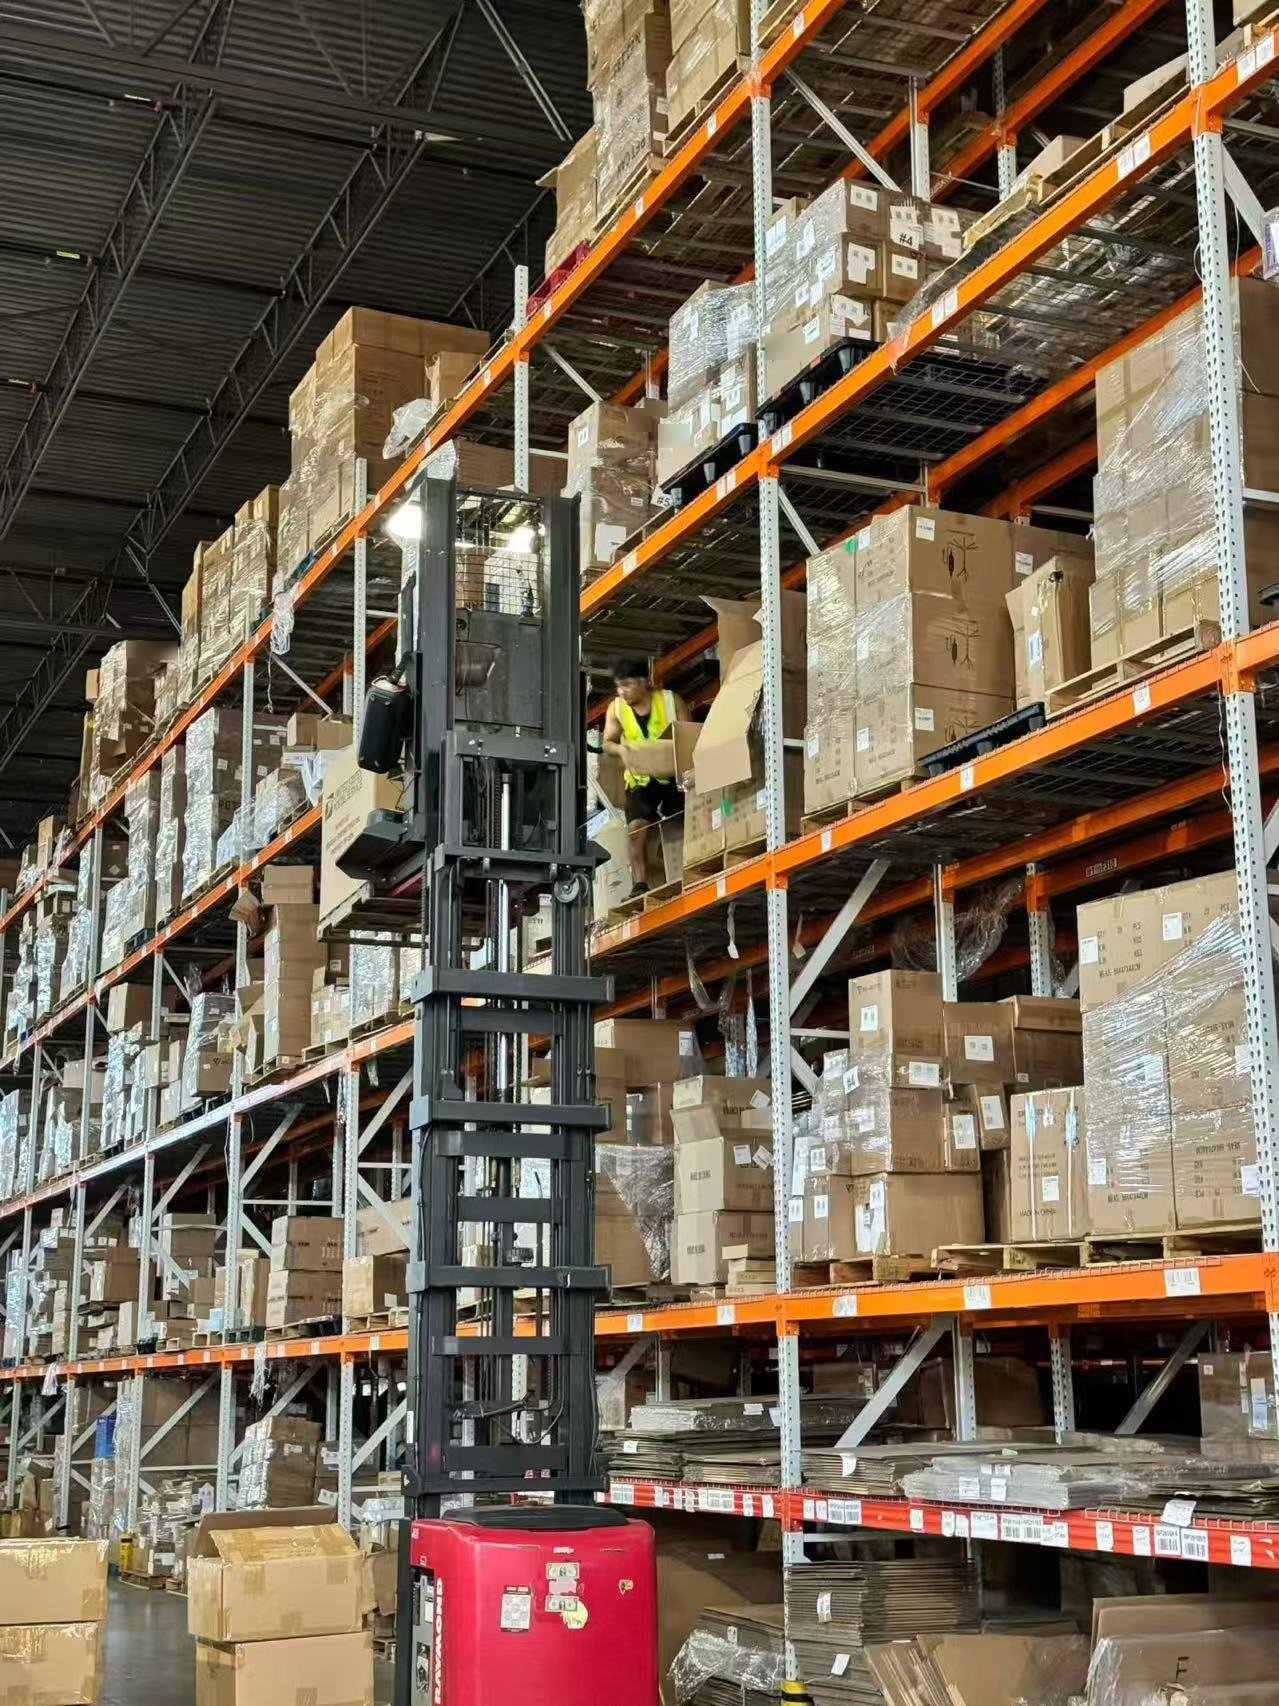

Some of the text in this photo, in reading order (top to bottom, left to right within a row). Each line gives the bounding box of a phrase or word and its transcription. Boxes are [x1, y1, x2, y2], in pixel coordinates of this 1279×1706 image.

[899, 232, 913, 246] #4
[657, 495, 671, 507] #5
[434, 1577, 443, 1705] RAYMOND
